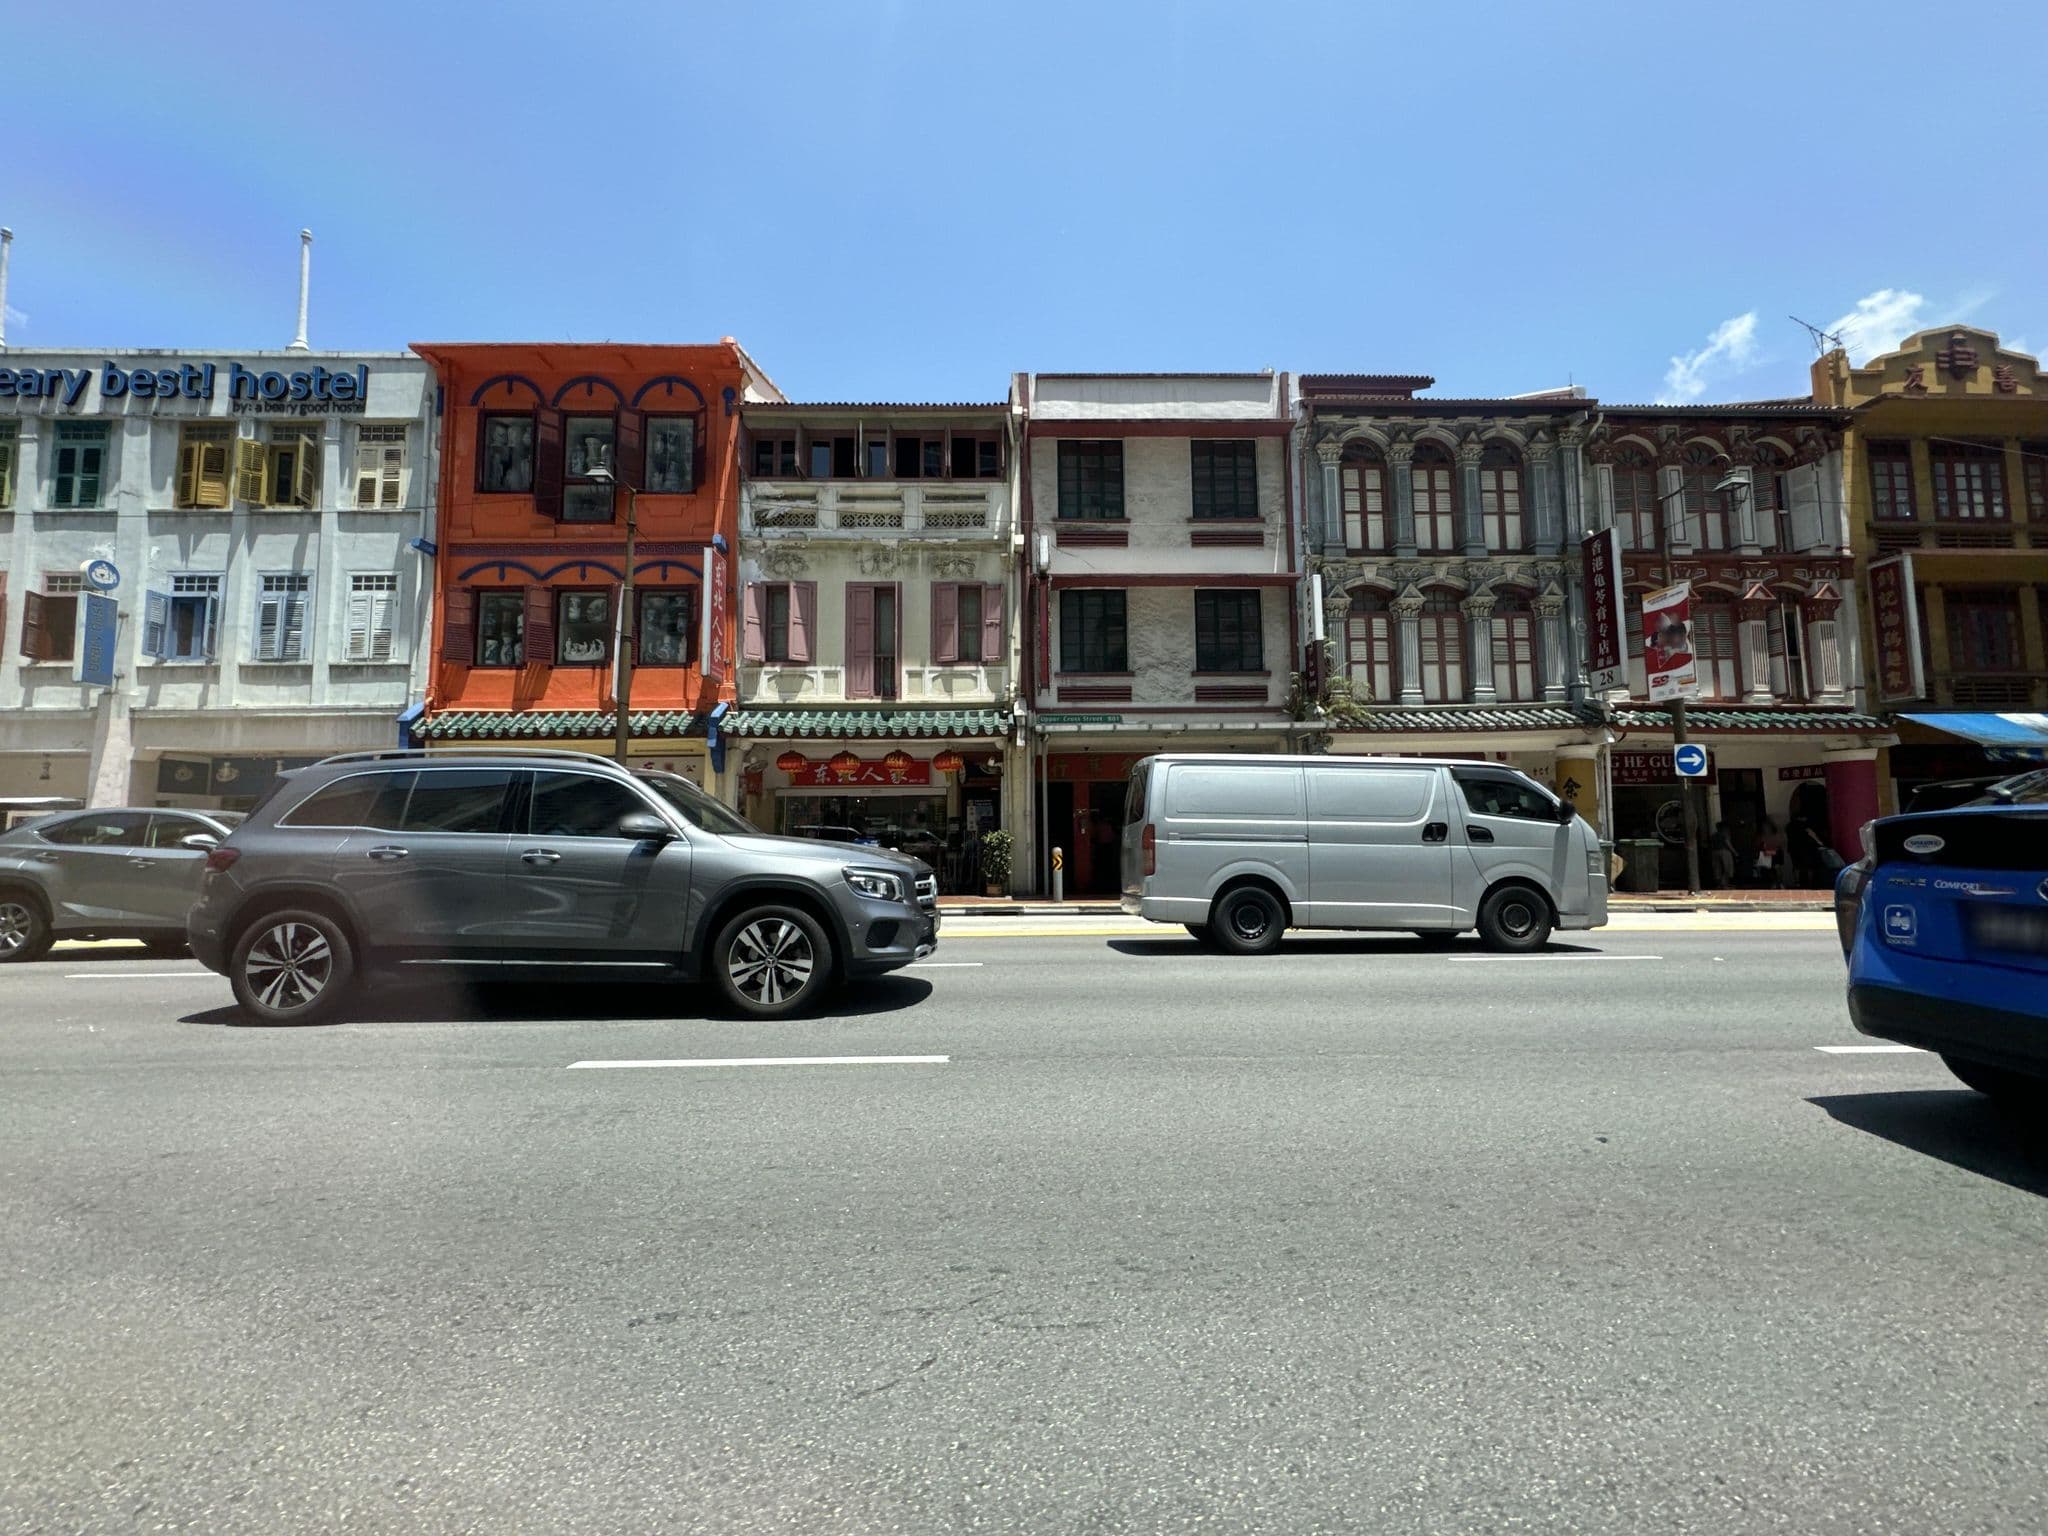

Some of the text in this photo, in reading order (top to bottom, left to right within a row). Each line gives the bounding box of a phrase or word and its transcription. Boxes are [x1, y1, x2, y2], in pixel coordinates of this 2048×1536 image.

[0, 360, 369, 406] eary best! hostel
[255, 404, 263, 412] a
[265, 401, 297, 413] beary
[300, 402, 330, 415] good
[1600, 671, 1614, 686] 28
[1040, 715, 1060, 723] Upper
[1624, 756, 1646, 768] HE
